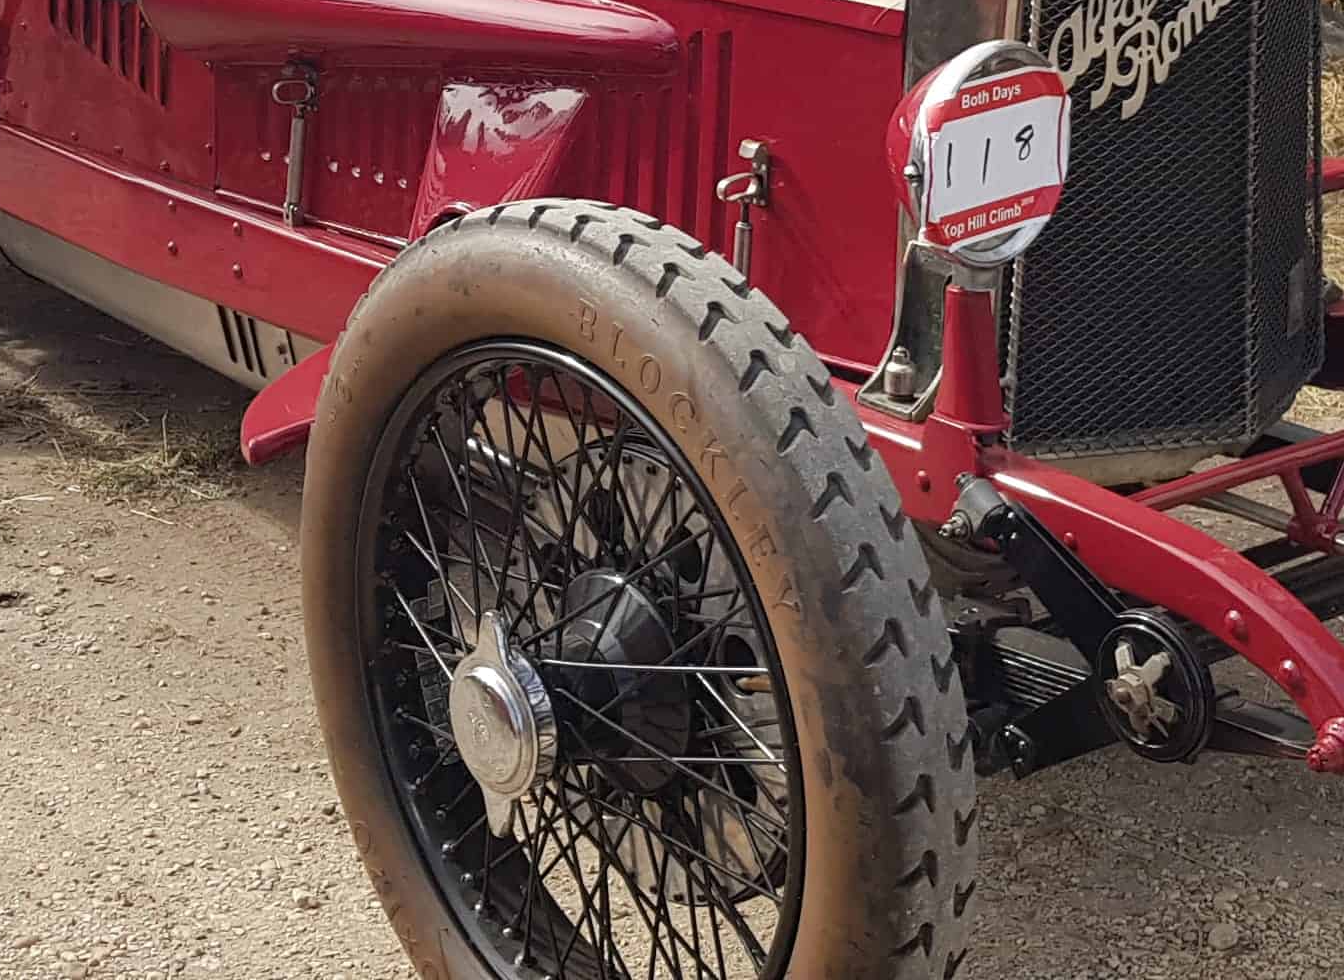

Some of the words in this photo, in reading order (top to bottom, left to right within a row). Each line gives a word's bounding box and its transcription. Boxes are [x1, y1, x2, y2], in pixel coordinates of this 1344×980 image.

[961, 89, 990, 109] Both
[992, 83, 1022, 101] Days
[967, 212, 987, 232] Hill
[989, 203, 1022, 224] Climb
[574, 297, 803, 614] BLOCKLEY
